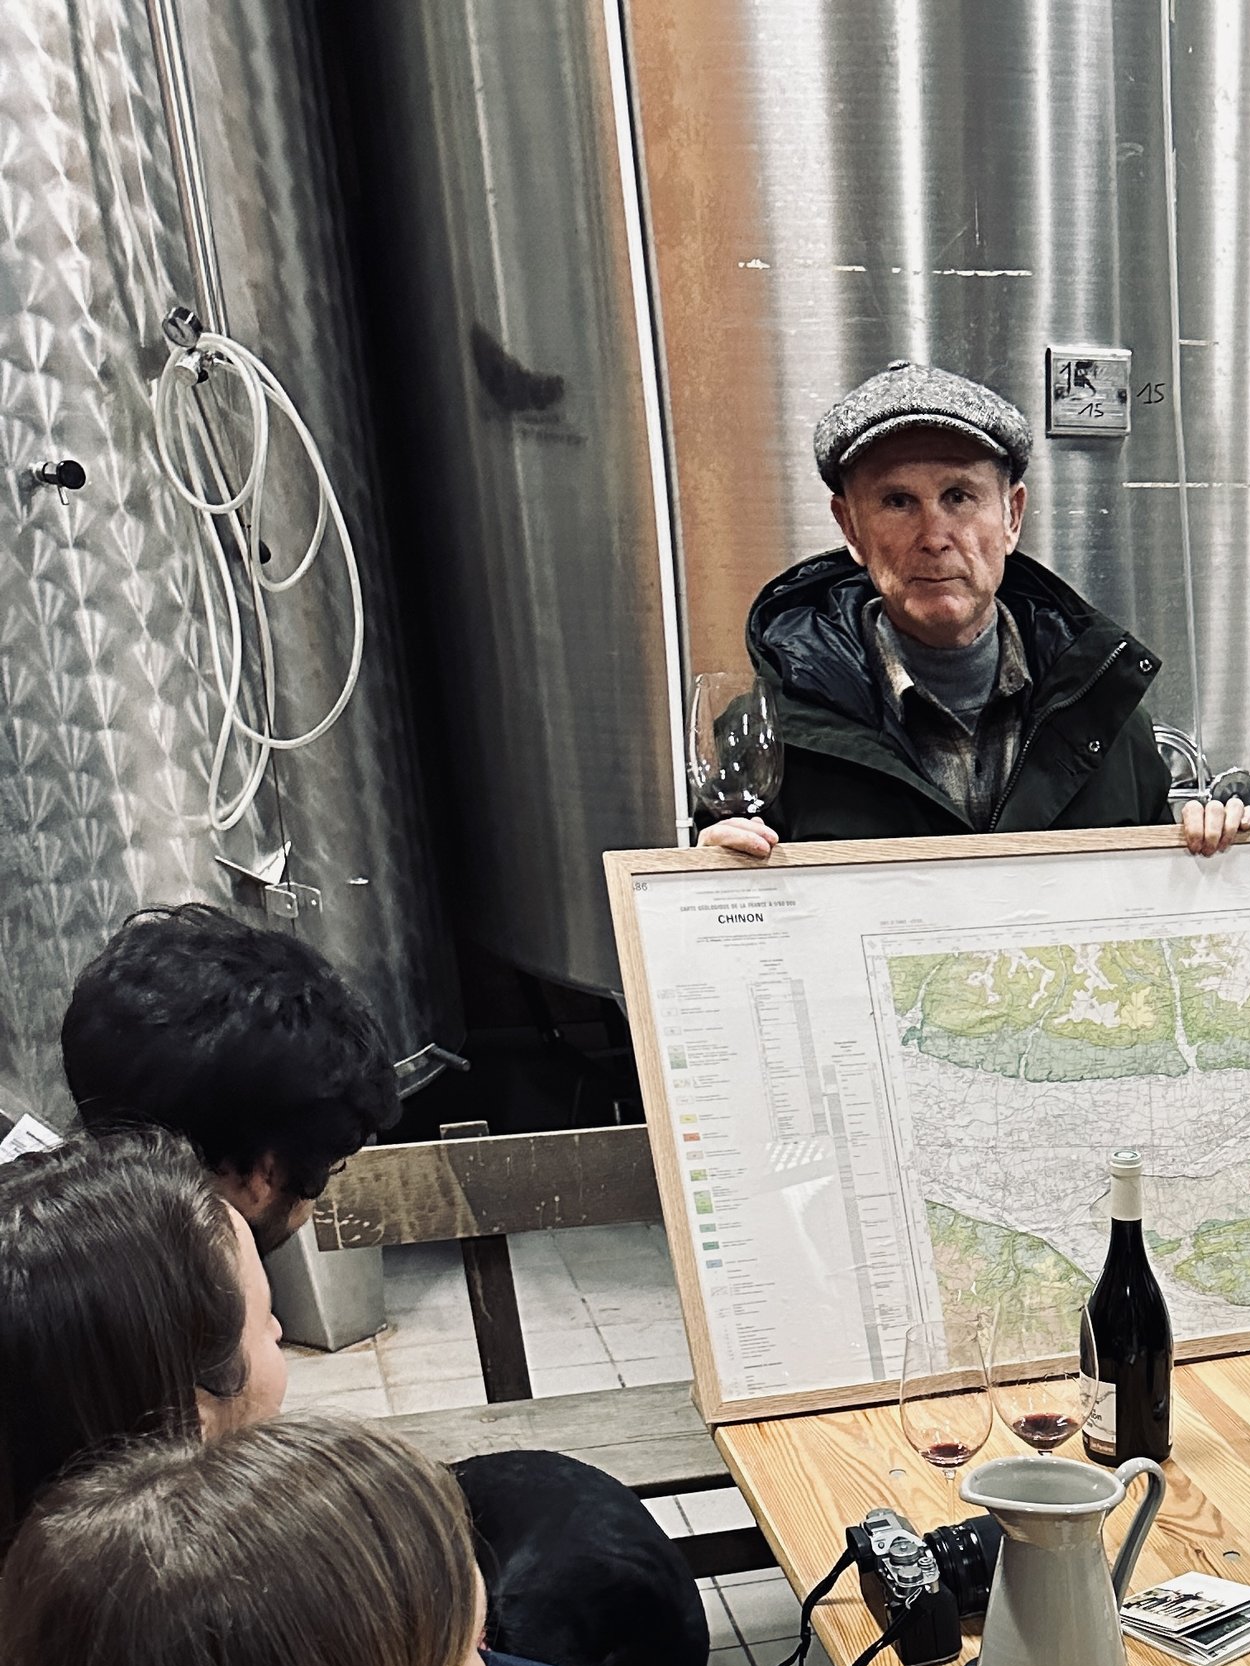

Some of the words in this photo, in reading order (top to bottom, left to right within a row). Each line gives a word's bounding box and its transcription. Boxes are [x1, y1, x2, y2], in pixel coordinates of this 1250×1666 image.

[1136, 383, 1166, 404] 15
[1078, 403, 1104, 418] 15
[718, 913, 764, 924] CHINON
